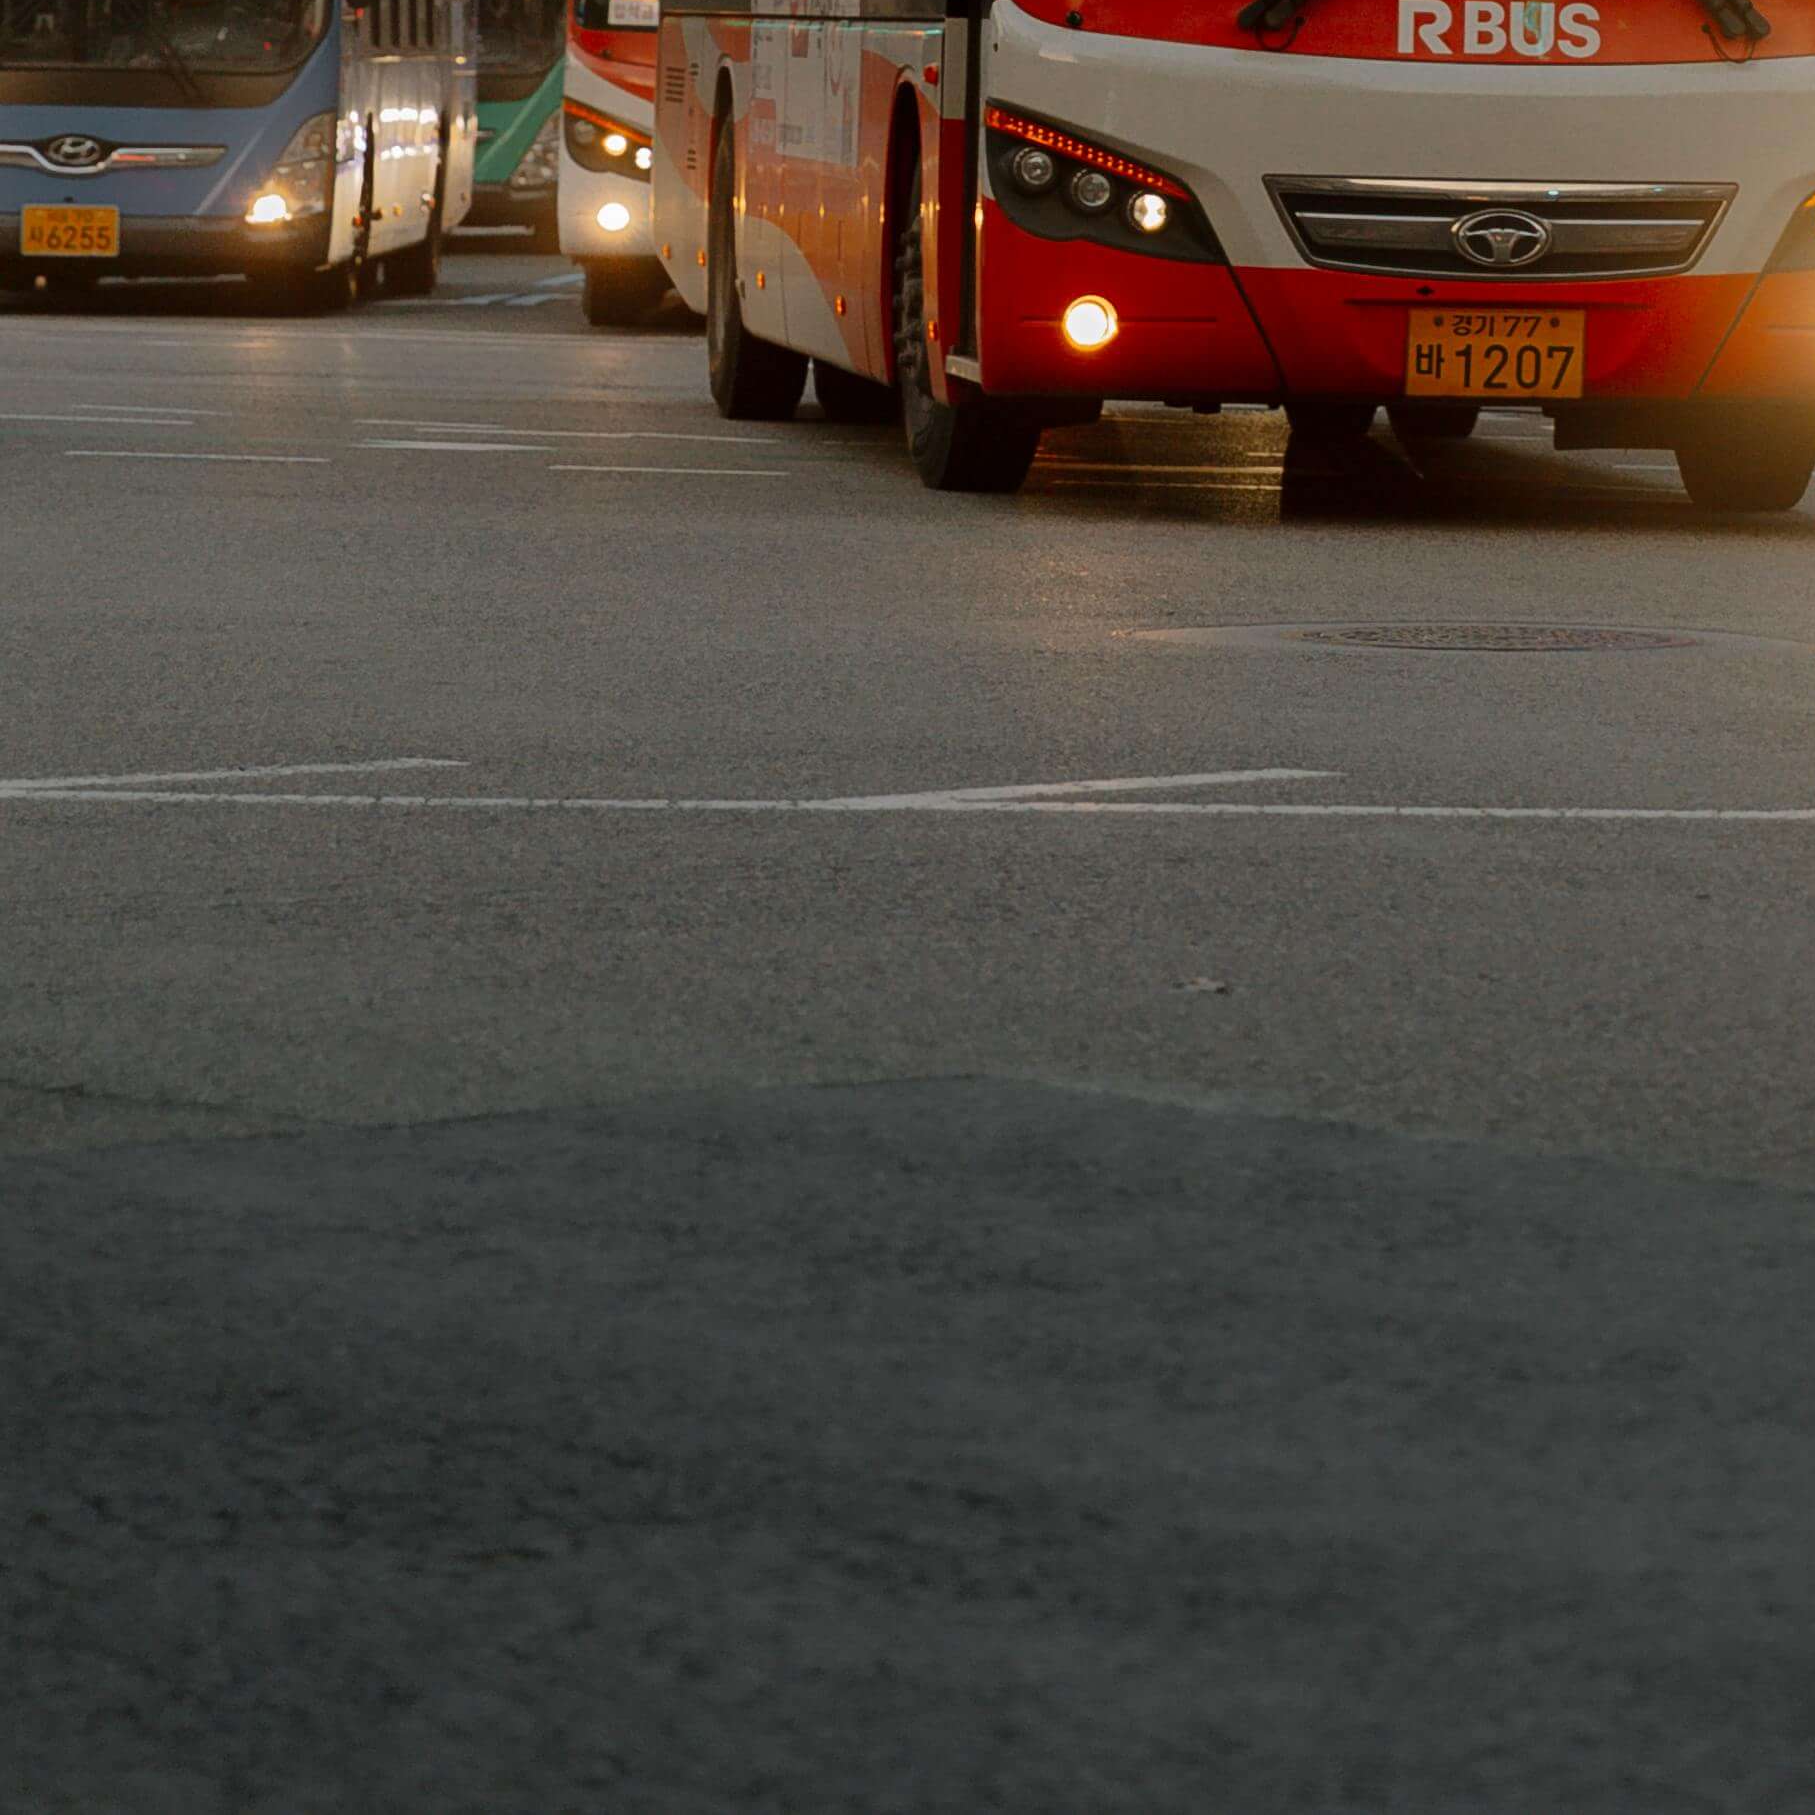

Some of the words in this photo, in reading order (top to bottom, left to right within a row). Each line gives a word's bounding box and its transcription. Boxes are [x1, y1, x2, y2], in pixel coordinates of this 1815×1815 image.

[1463, 0, 1601, 59] BUS
[1452, 315, 1495, 337] 경기
[1503, 316, 1542, 338] 77
